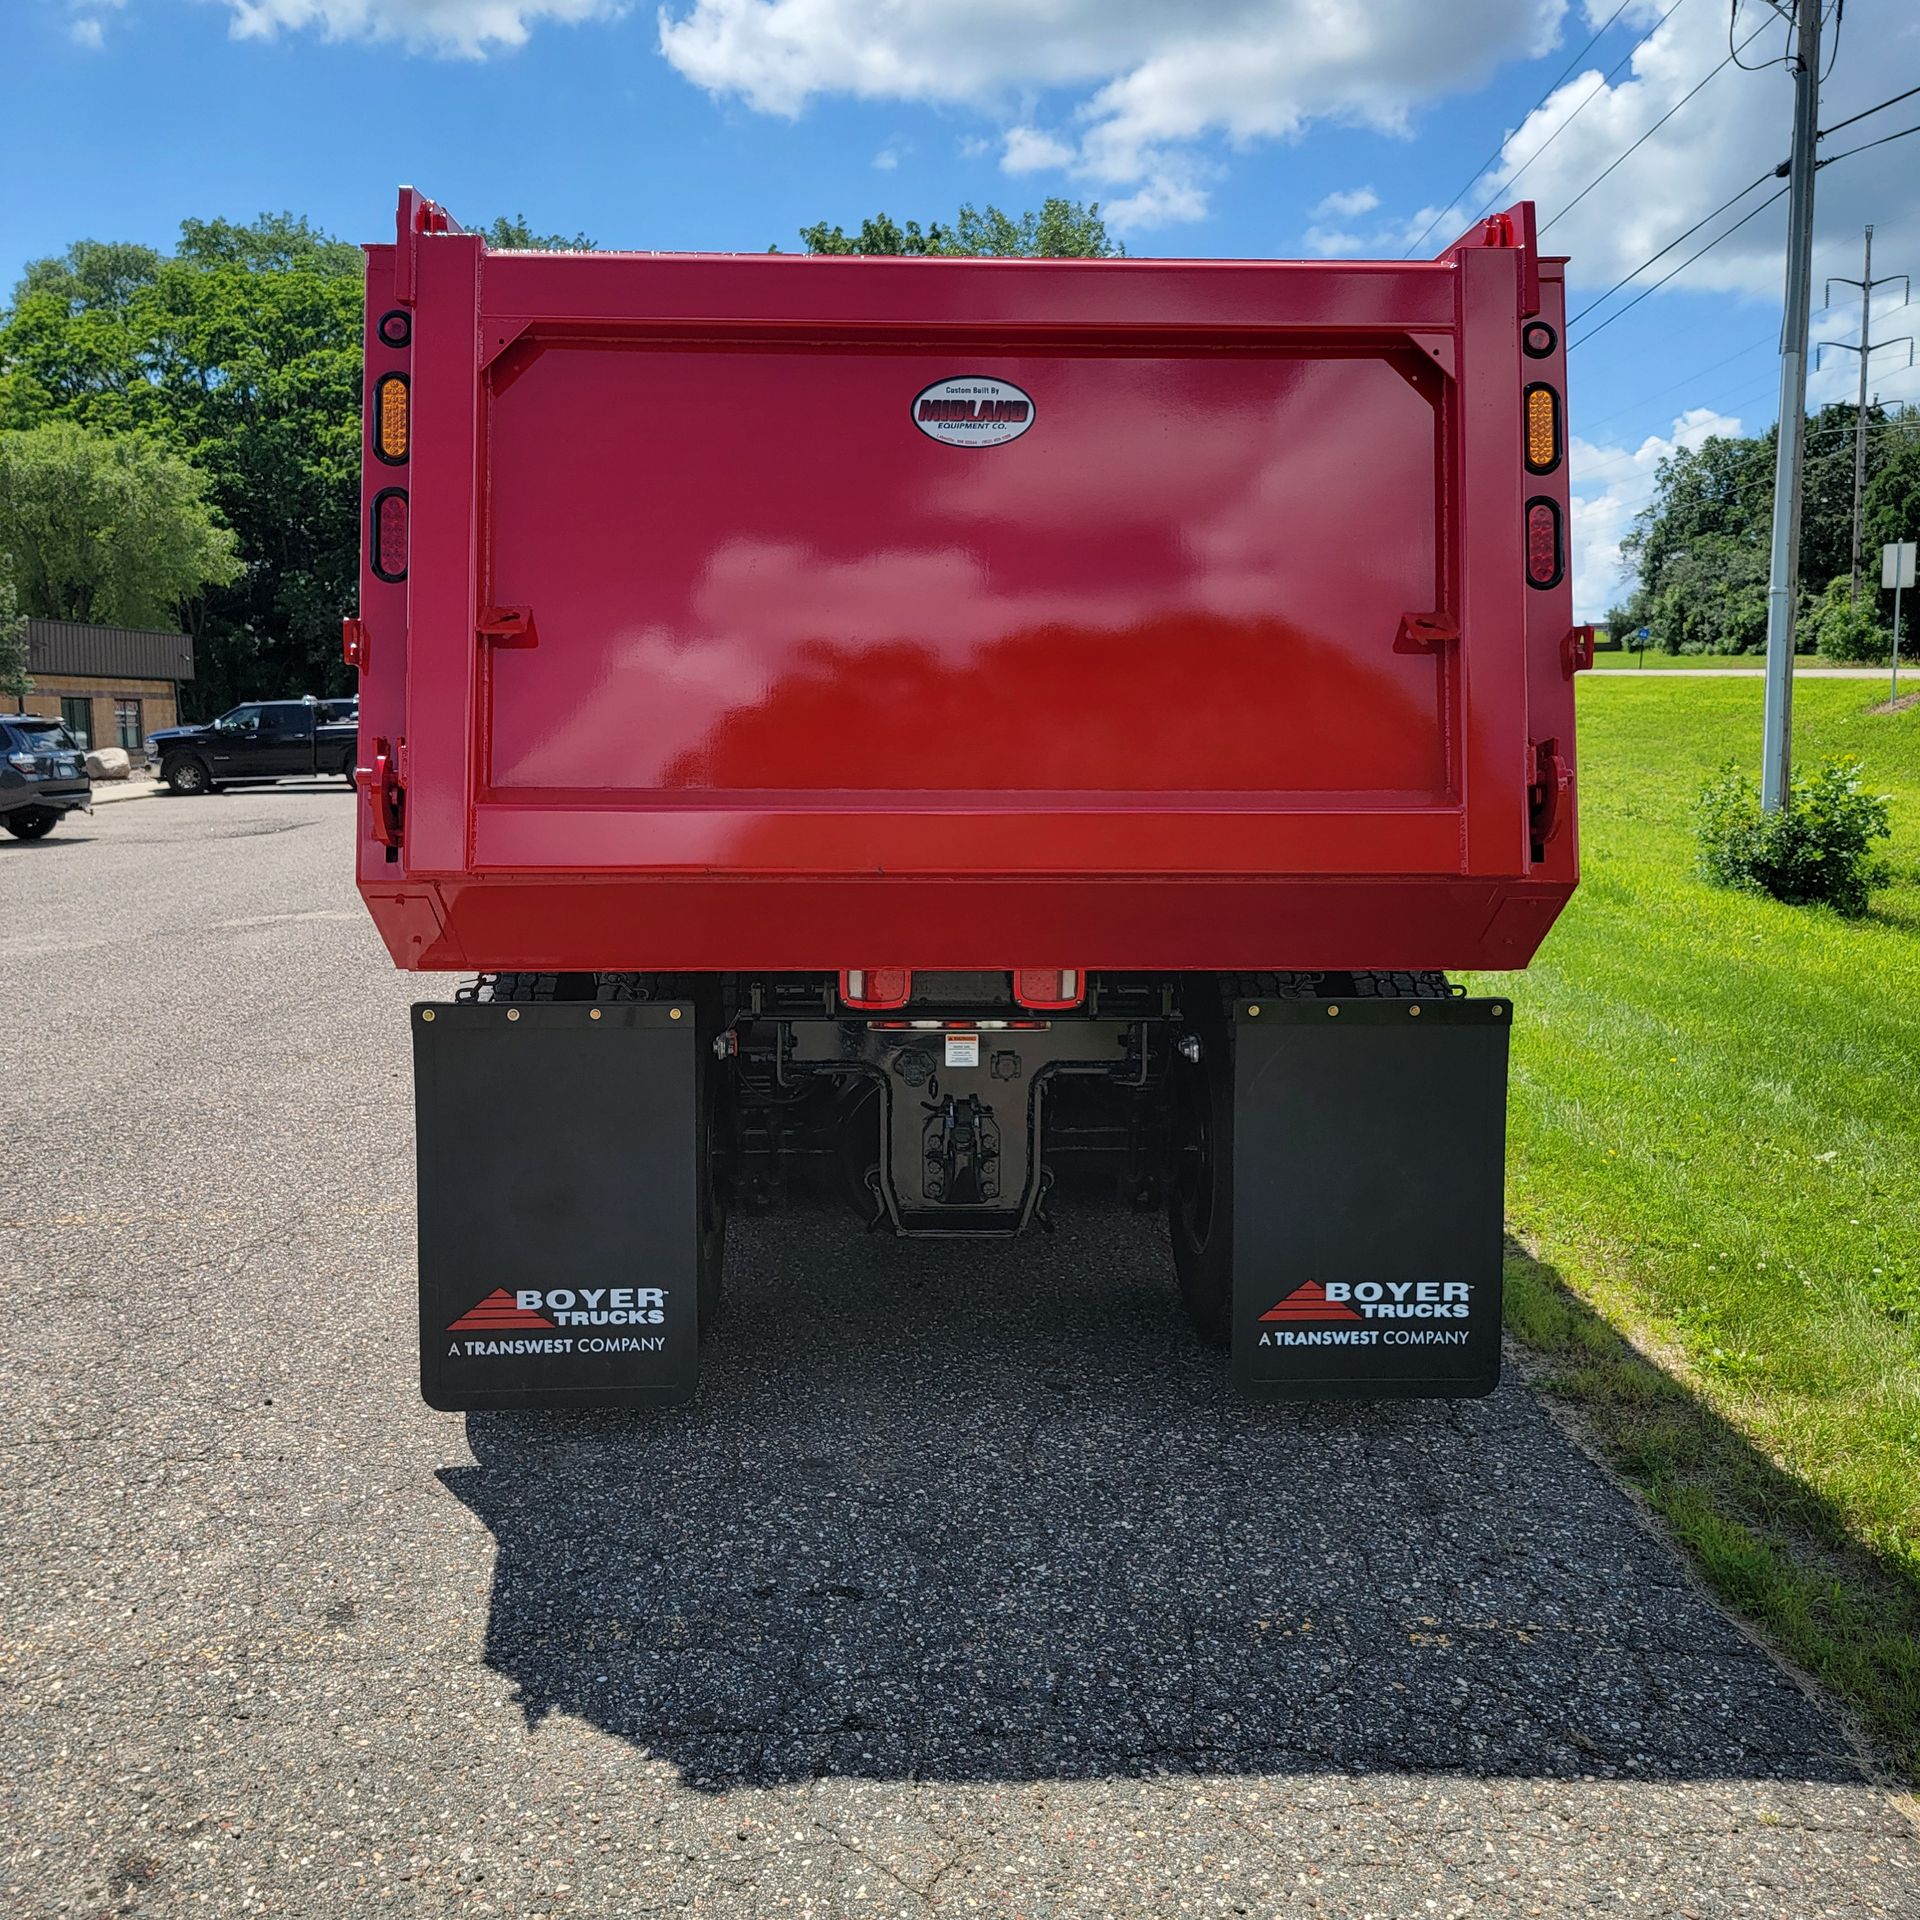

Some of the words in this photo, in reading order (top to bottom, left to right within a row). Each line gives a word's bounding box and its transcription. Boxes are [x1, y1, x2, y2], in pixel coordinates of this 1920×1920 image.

[945, 386, 971, 394] Custom
[973, 386, 989, 394] Built
[991, 386, 1000, 395] By
[918, 399, 1030, 422] MIDLAND
[937, 422, 989, 430] EQUIPMENT
[516, 1287, 664, 1310] BOYER
[1325, 1281, 1470, 1302] BOYER
[553, 1309, 665, 1326] TRUCKS
[1360, 1303, 1470, 1318] TRUCKS
[448, 1342, 461, 1357] A
[464, 1338, 574, 1356] TRANSWEST
[577, 1336, 666, 1353] COMPANY
[1258, 1332, 1271, 1346] A
[1274, 1331, 1379, 1346] TRANSWEST
[1382, 1330, 1470, 1345] COMPANY
